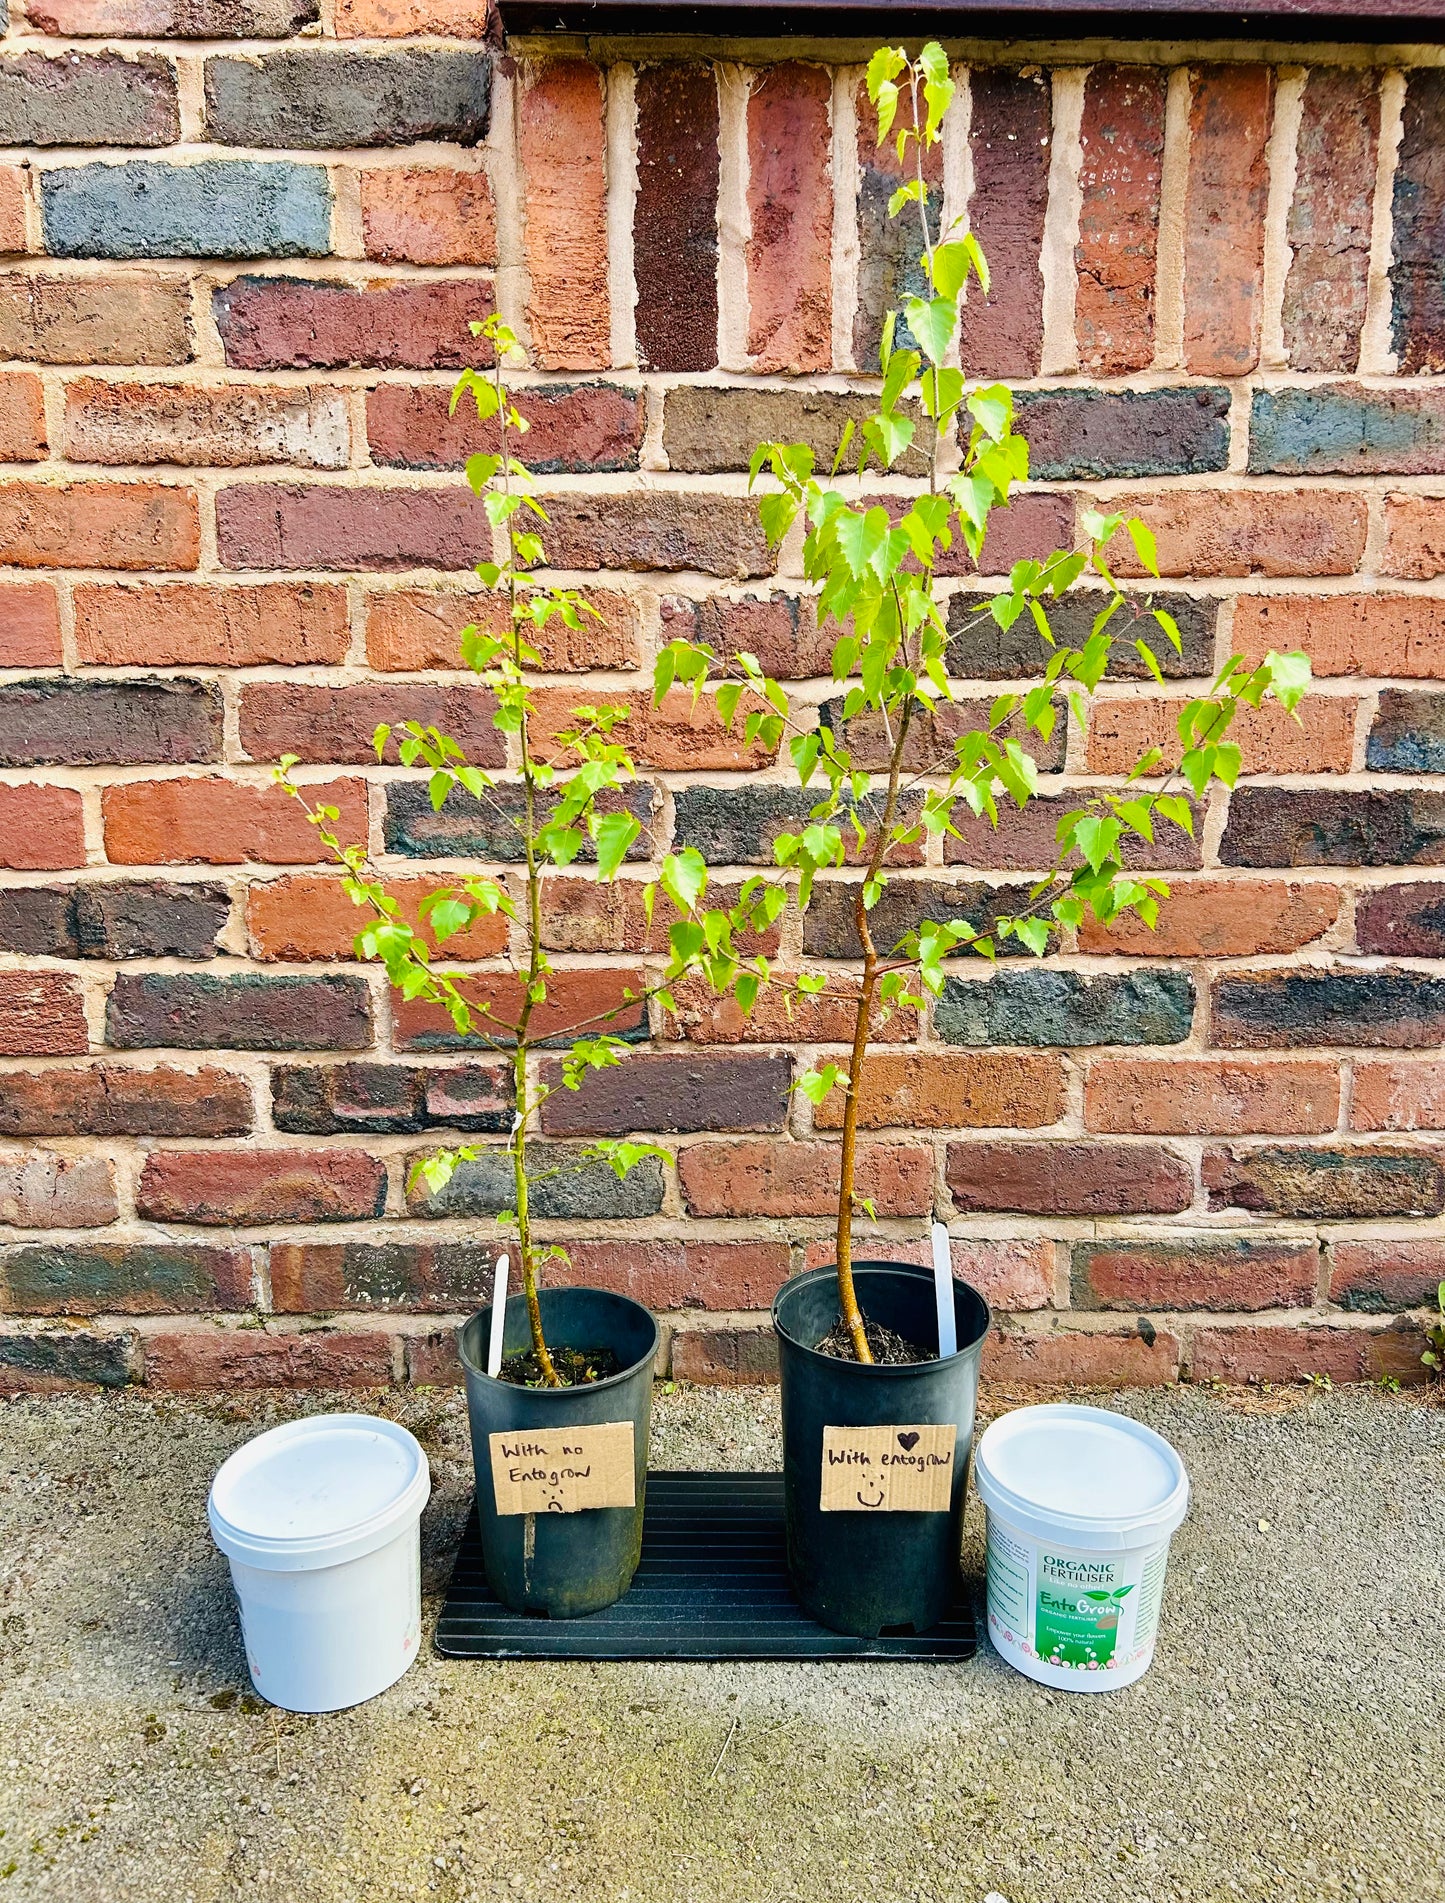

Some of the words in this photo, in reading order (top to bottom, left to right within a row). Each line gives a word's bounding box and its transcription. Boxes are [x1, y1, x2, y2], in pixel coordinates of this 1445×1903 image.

[502, 1443, 548, 1458] With
[563, 1446, 583, 1455] no
[829, 1449, 871, 1466] With
[509, 1465, 590, 1486] Entogrow
[1043, 1555, 1115, 1573] ORGANIC
[1043, 1564, 1114, 1583] FERTILISER
[1039, 1590, 1116, 1615] EntoGrow
[1040, 1607, 1068, 1619] ORGANIC
[1058, 1635, 1074, 1644] 100%
[1072, 1631, 1085, 1639] your
